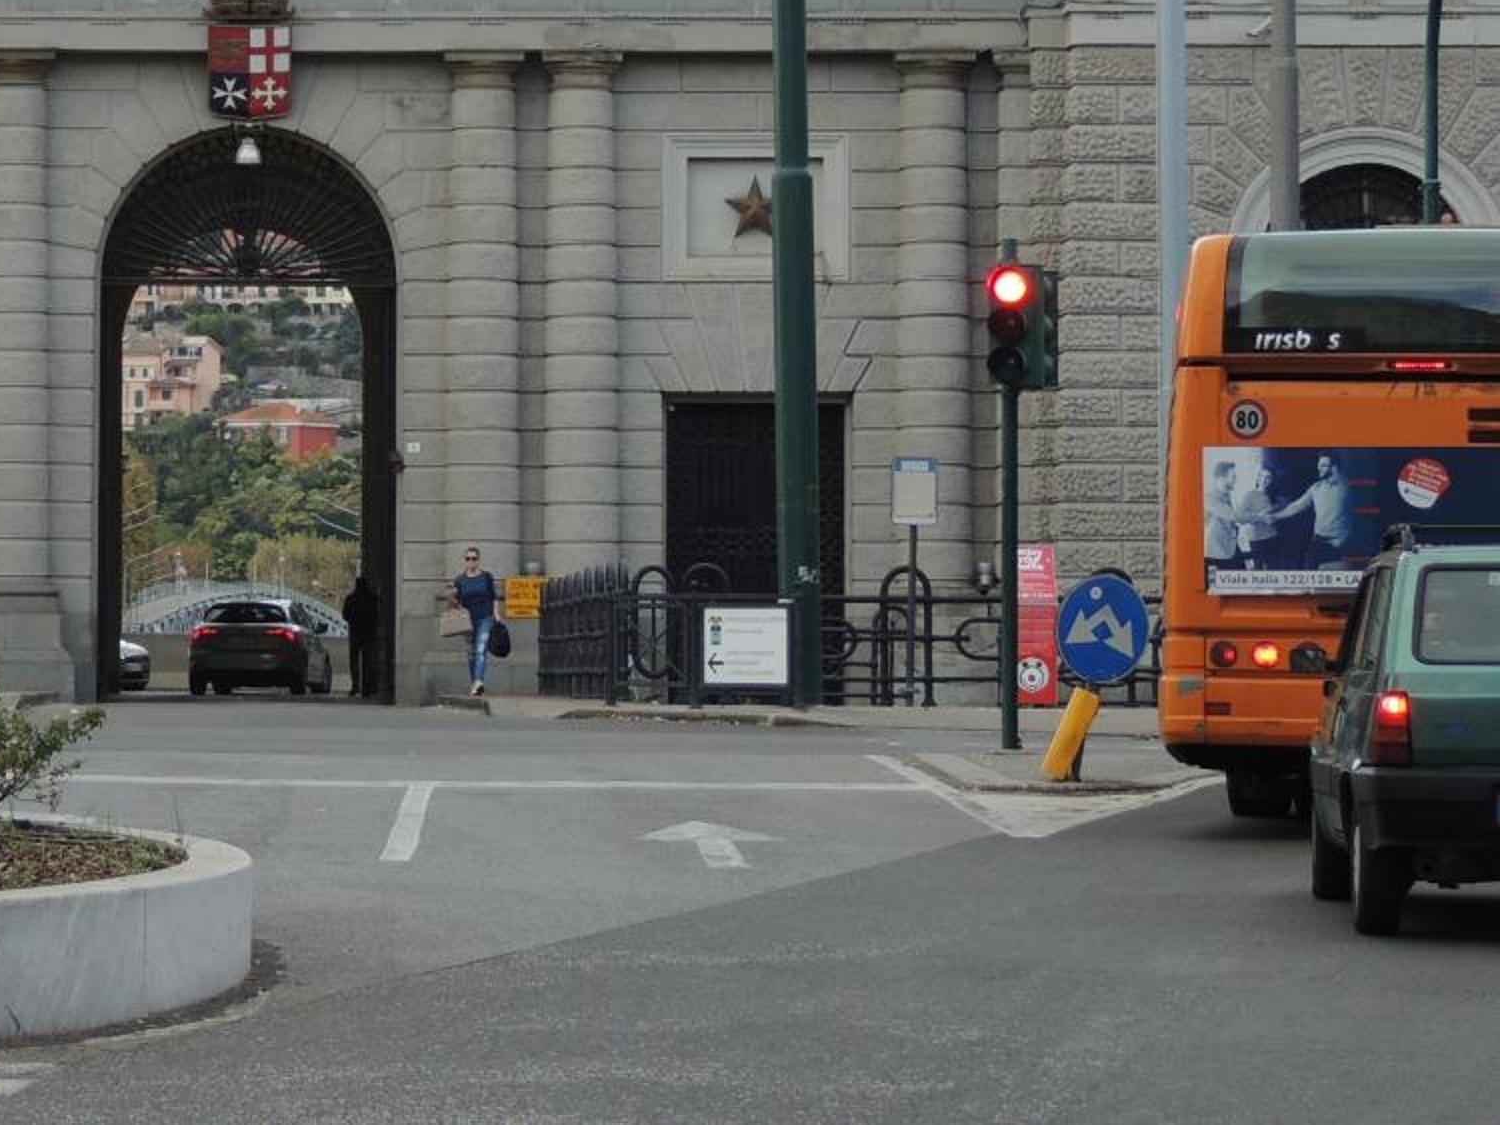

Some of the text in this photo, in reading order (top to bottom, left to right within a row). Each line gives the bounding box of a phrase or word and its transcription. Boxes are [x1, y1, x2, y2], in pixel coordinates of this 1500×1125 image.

[1235, 410, 1260, 430] 80
[1219, 573, 1248, 585] Viale
[1251, 574, 1279, 585] Italia
